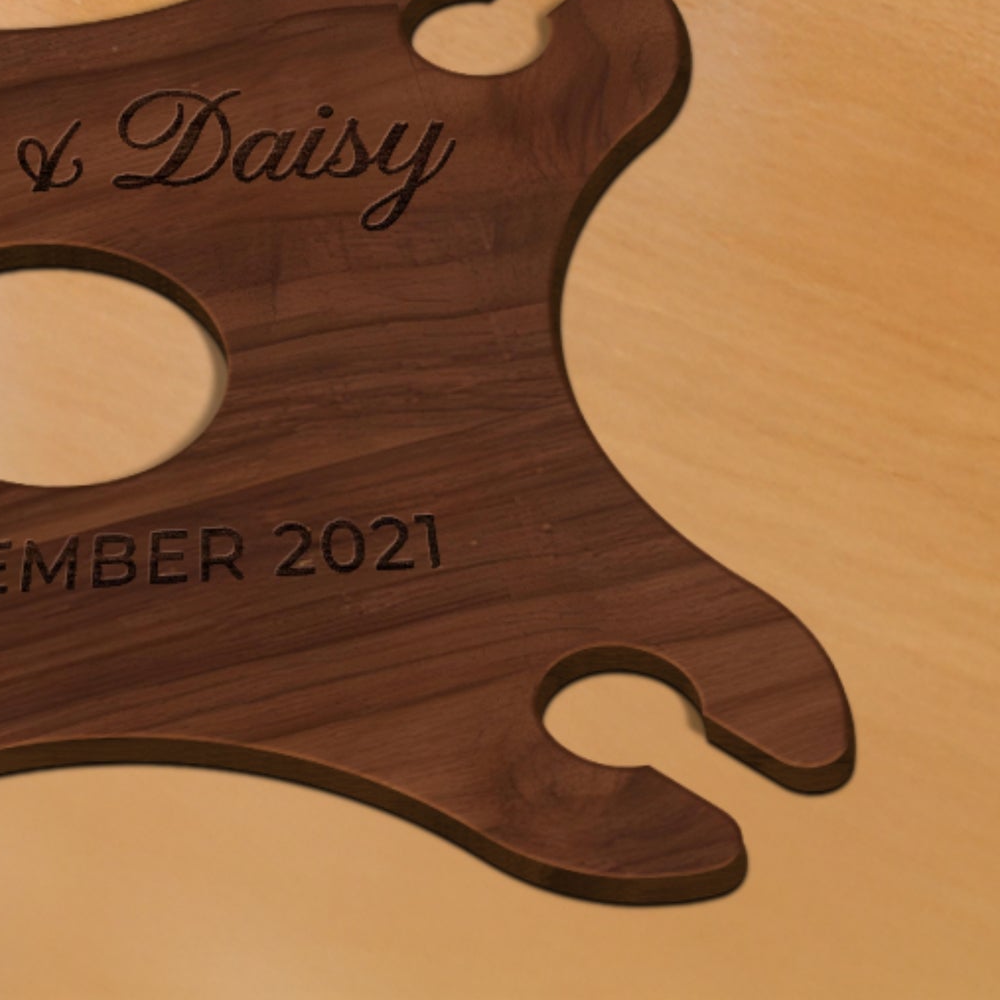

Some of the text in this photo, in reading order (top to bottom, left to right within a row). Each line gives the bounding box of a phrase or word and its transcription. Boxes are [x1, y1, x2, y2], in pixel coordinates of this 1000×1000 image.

[16, 120, 83, 192] &
[112, 88, 457, 231] Daisy
[272, 513, 443, 578] 2021
